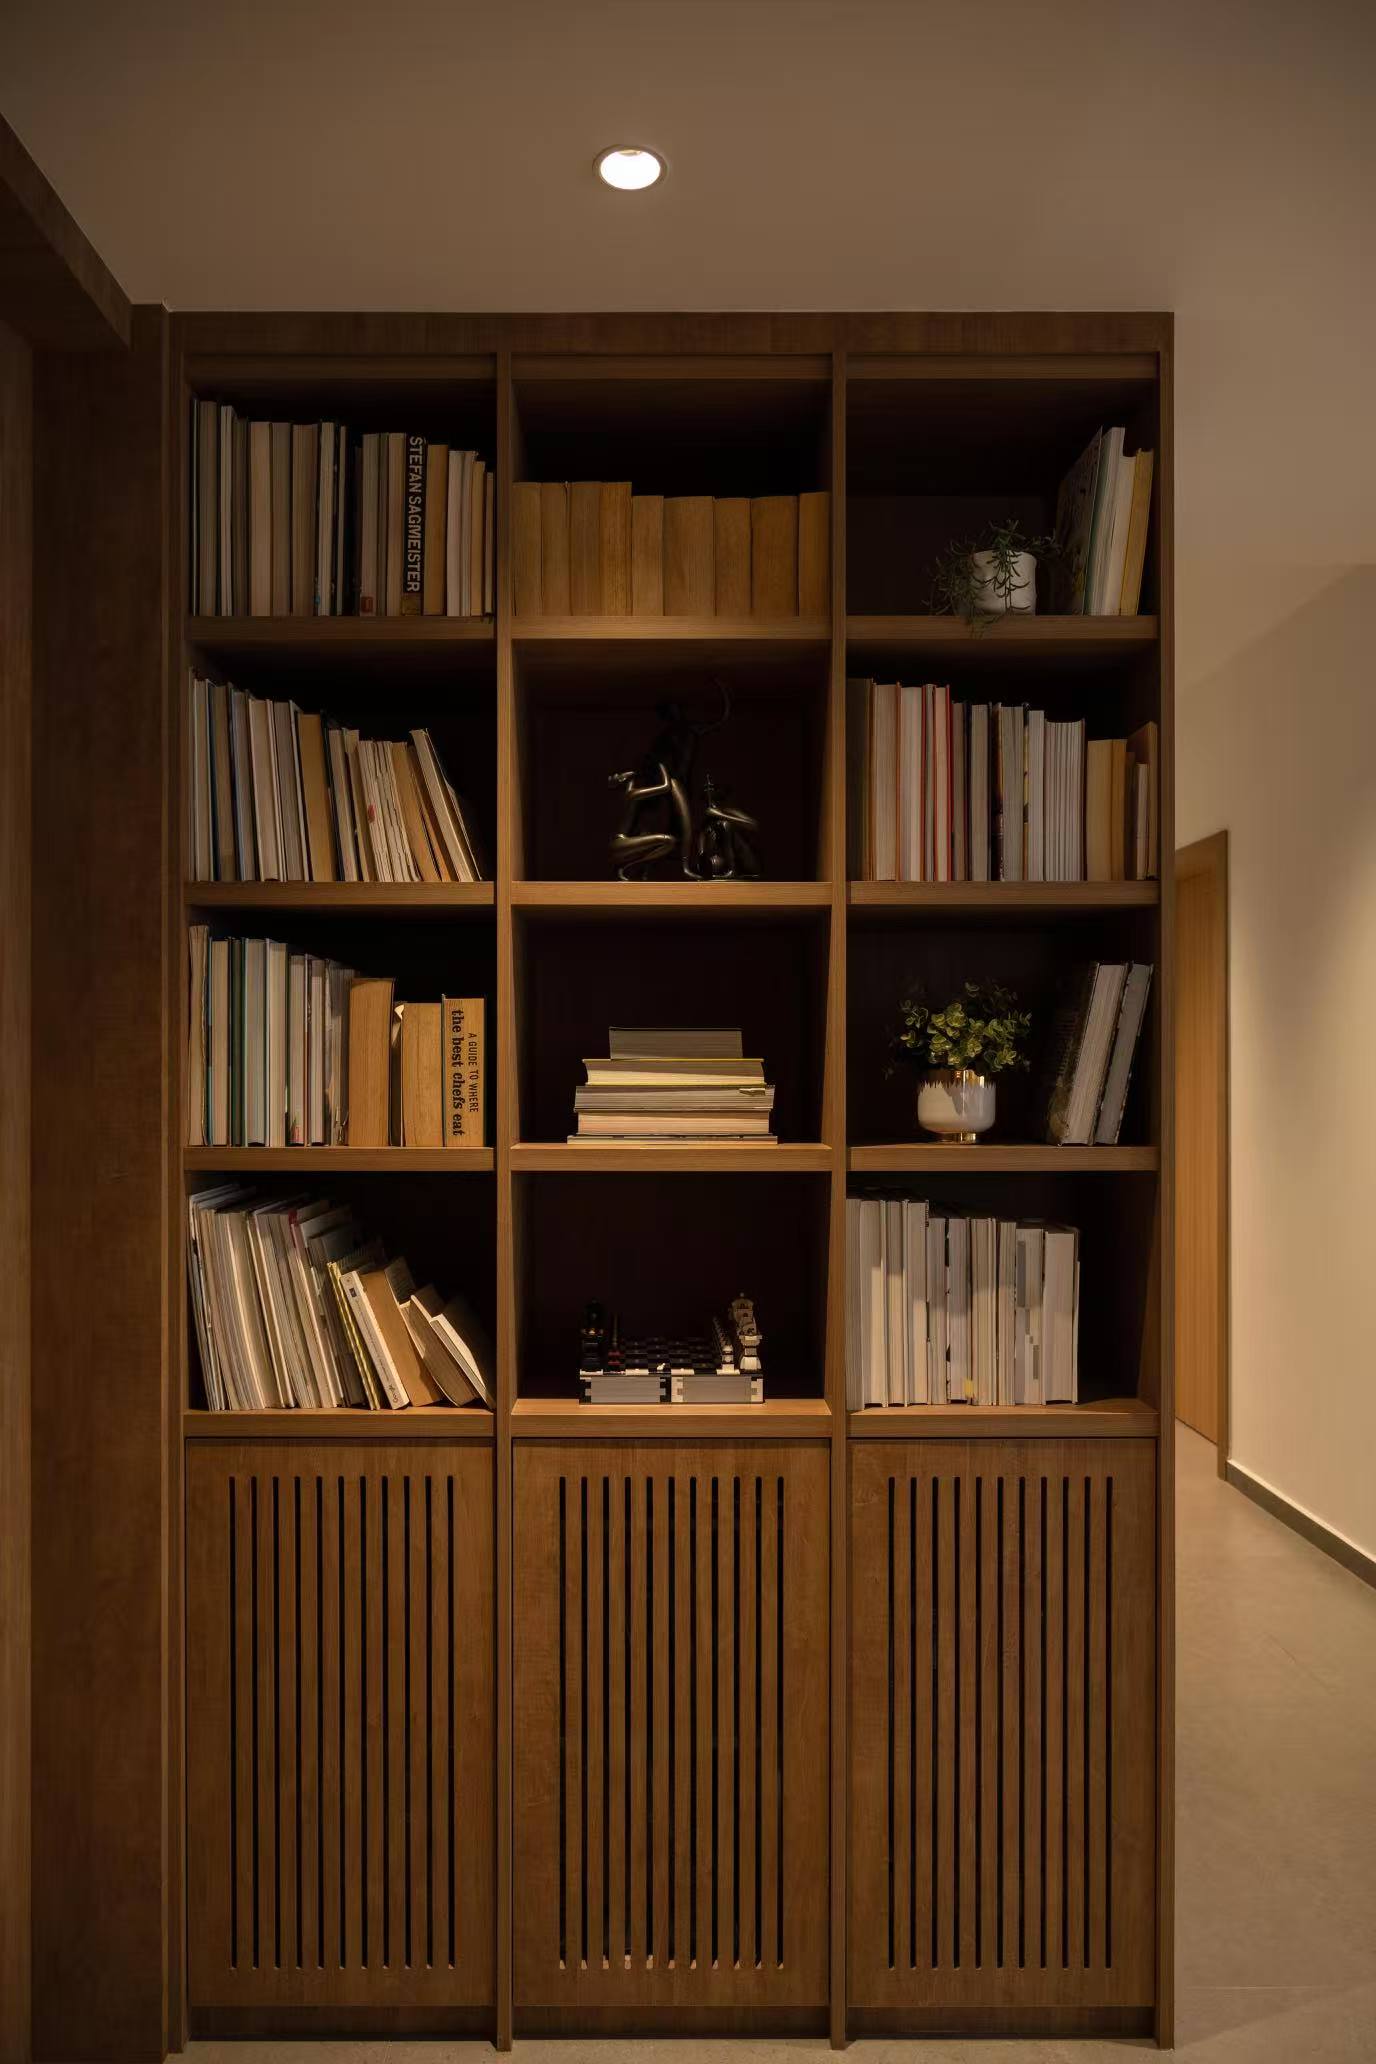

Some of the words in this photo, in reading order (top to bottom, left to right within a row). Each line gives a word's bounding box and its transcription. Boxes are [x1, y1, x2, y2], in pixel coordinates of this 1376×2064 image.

[408, 436, 423, 493] STEFAN
[407, 495, 422, 592] SAGMEISTER
[452, 1009, 464, 1033] the
[452, 1037, 464, 1068] best
[468, 1041, 477, 1066] GUIDE
[469, 1069, 478, 1080] TO
[452, 1072, 466, 1109] chefs
[468, 1083, 478, 1113] WHERE
[453, 1113, 465, 1136] eat
